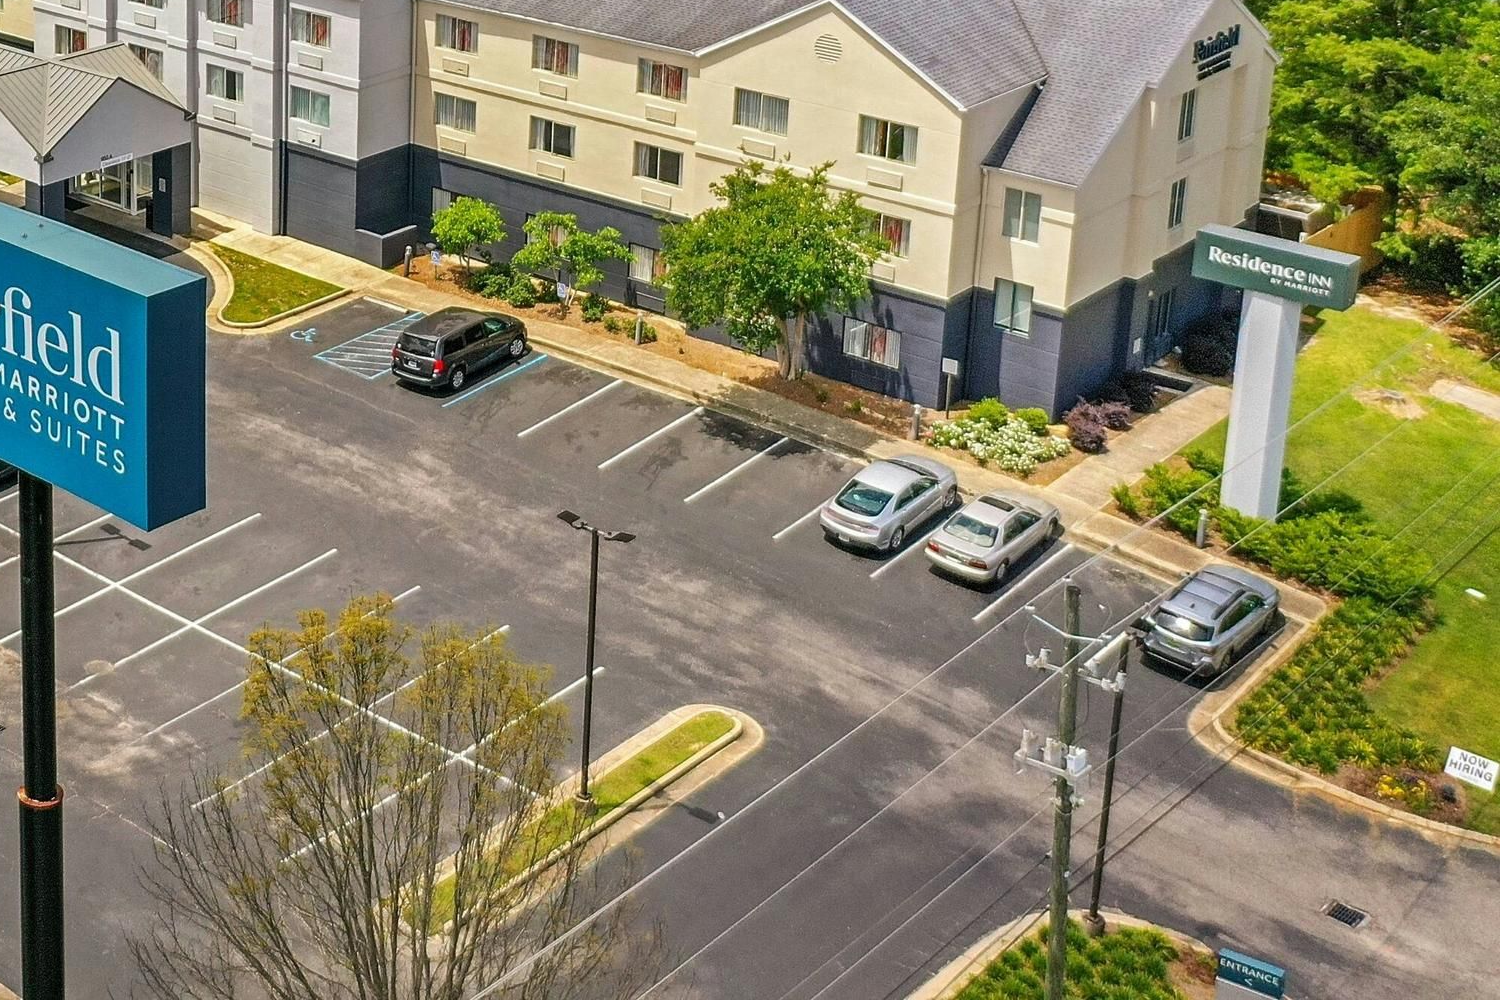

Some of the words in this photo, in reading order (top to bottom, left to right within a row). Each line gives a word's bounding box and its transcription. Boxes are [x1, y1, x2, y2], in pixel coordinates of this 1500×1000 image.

[1208, 245, 1308, 282] Residence
[1308, 272, 1332, 288] INN
[1270, 277, 1282, 286] BY
[1284, 281, 1331, 297] MARRIOTT
[3, 397, 17, 422] &
[30, 409, 126, 475] SUITES
[1449, 758, 1493, 782] HIRING
[1459, 752, 1489, 769] NOW
[1220, 958, 1279, 986] ENTRANCE
